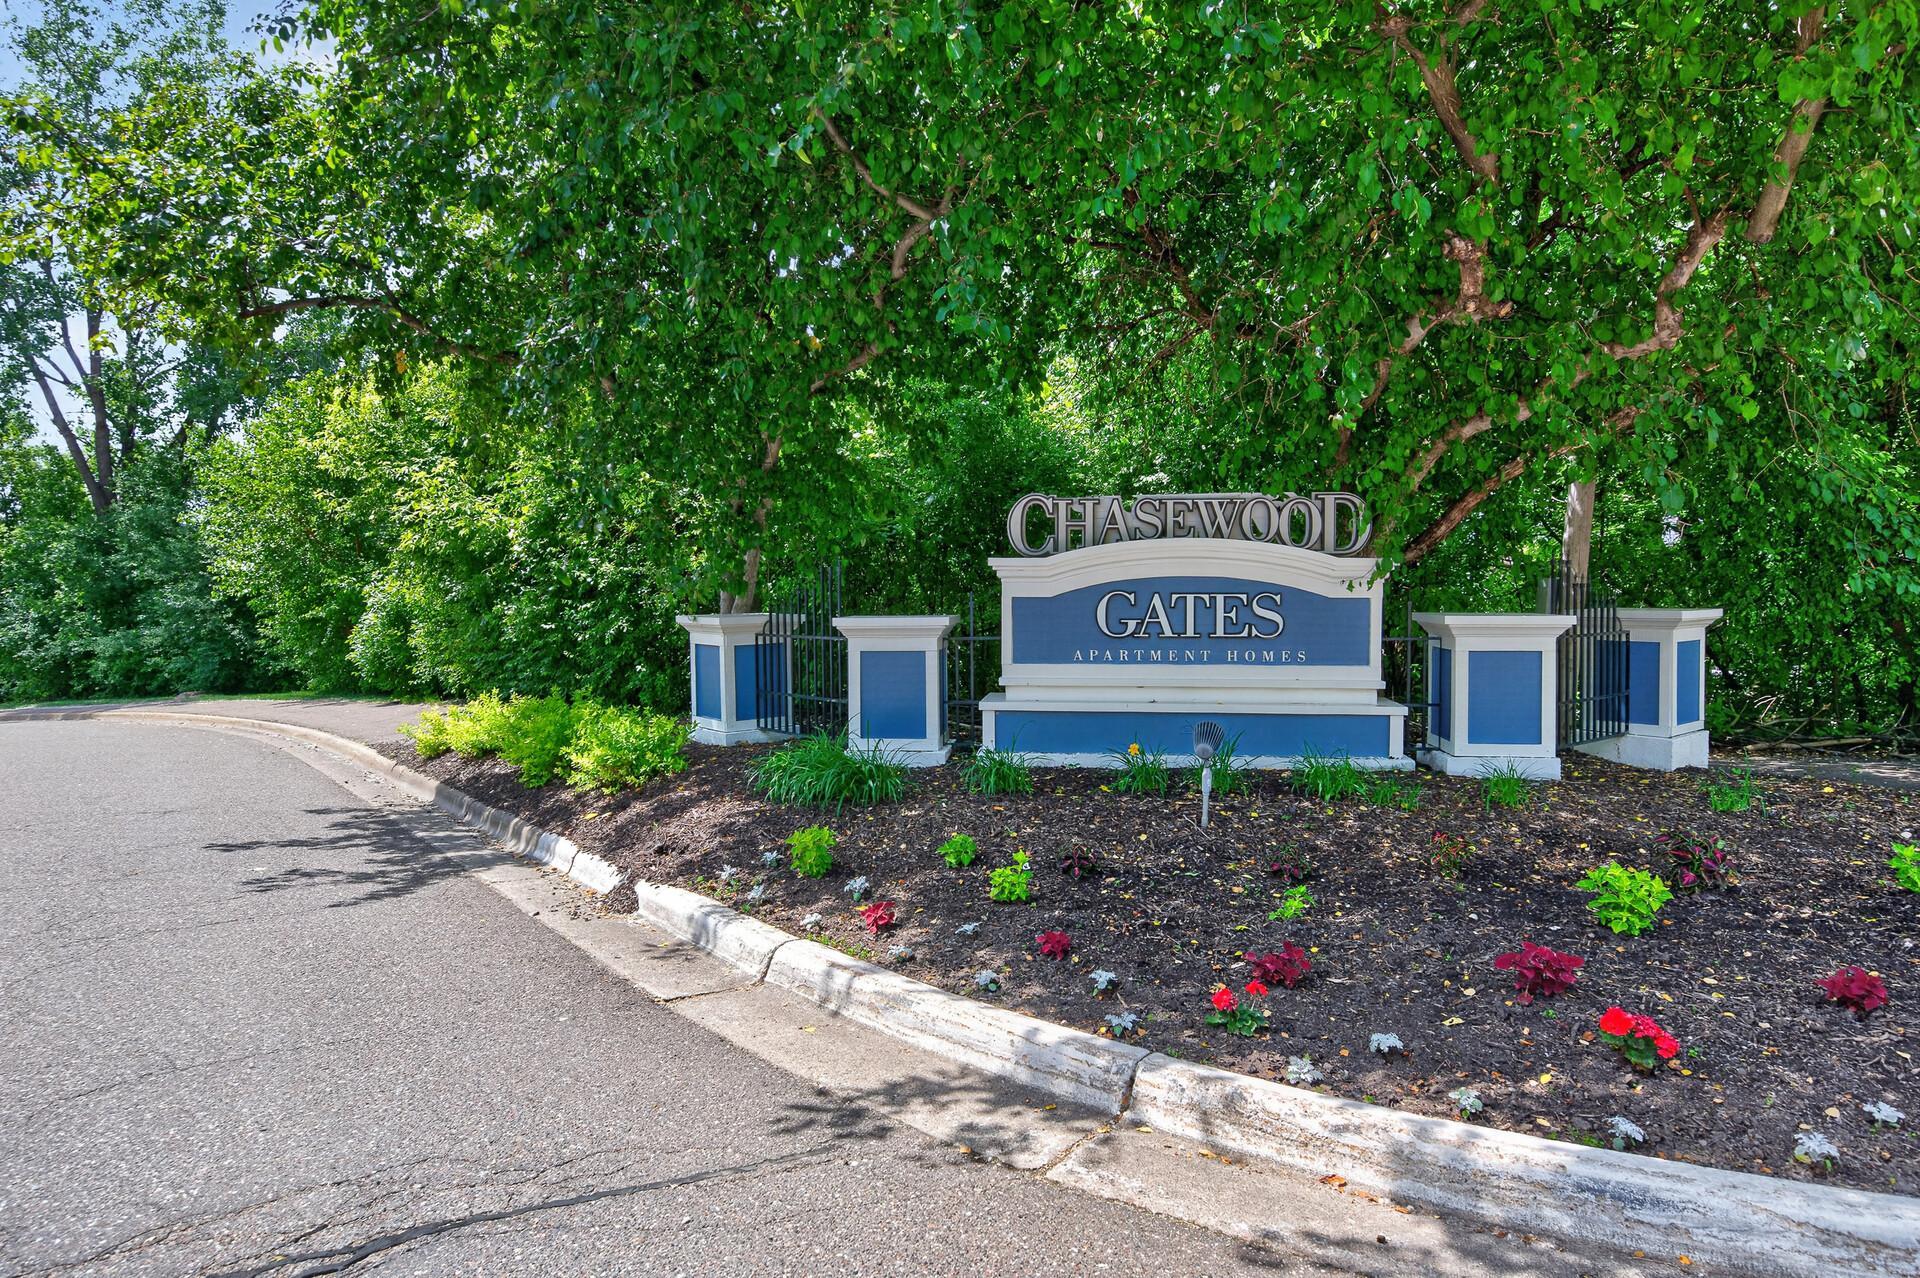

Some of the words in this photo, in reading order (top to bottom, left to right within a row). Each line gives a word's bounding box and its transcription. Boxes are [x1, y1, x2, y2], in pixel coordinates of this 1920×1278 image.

[1007, 492, 1373, 556] CHASEWOOD
[1095, 590, 1285, 639] GATES
[1073, 649, 1211, 662] APARTMENT
[1226, 649, 1307, 663] HOMES
